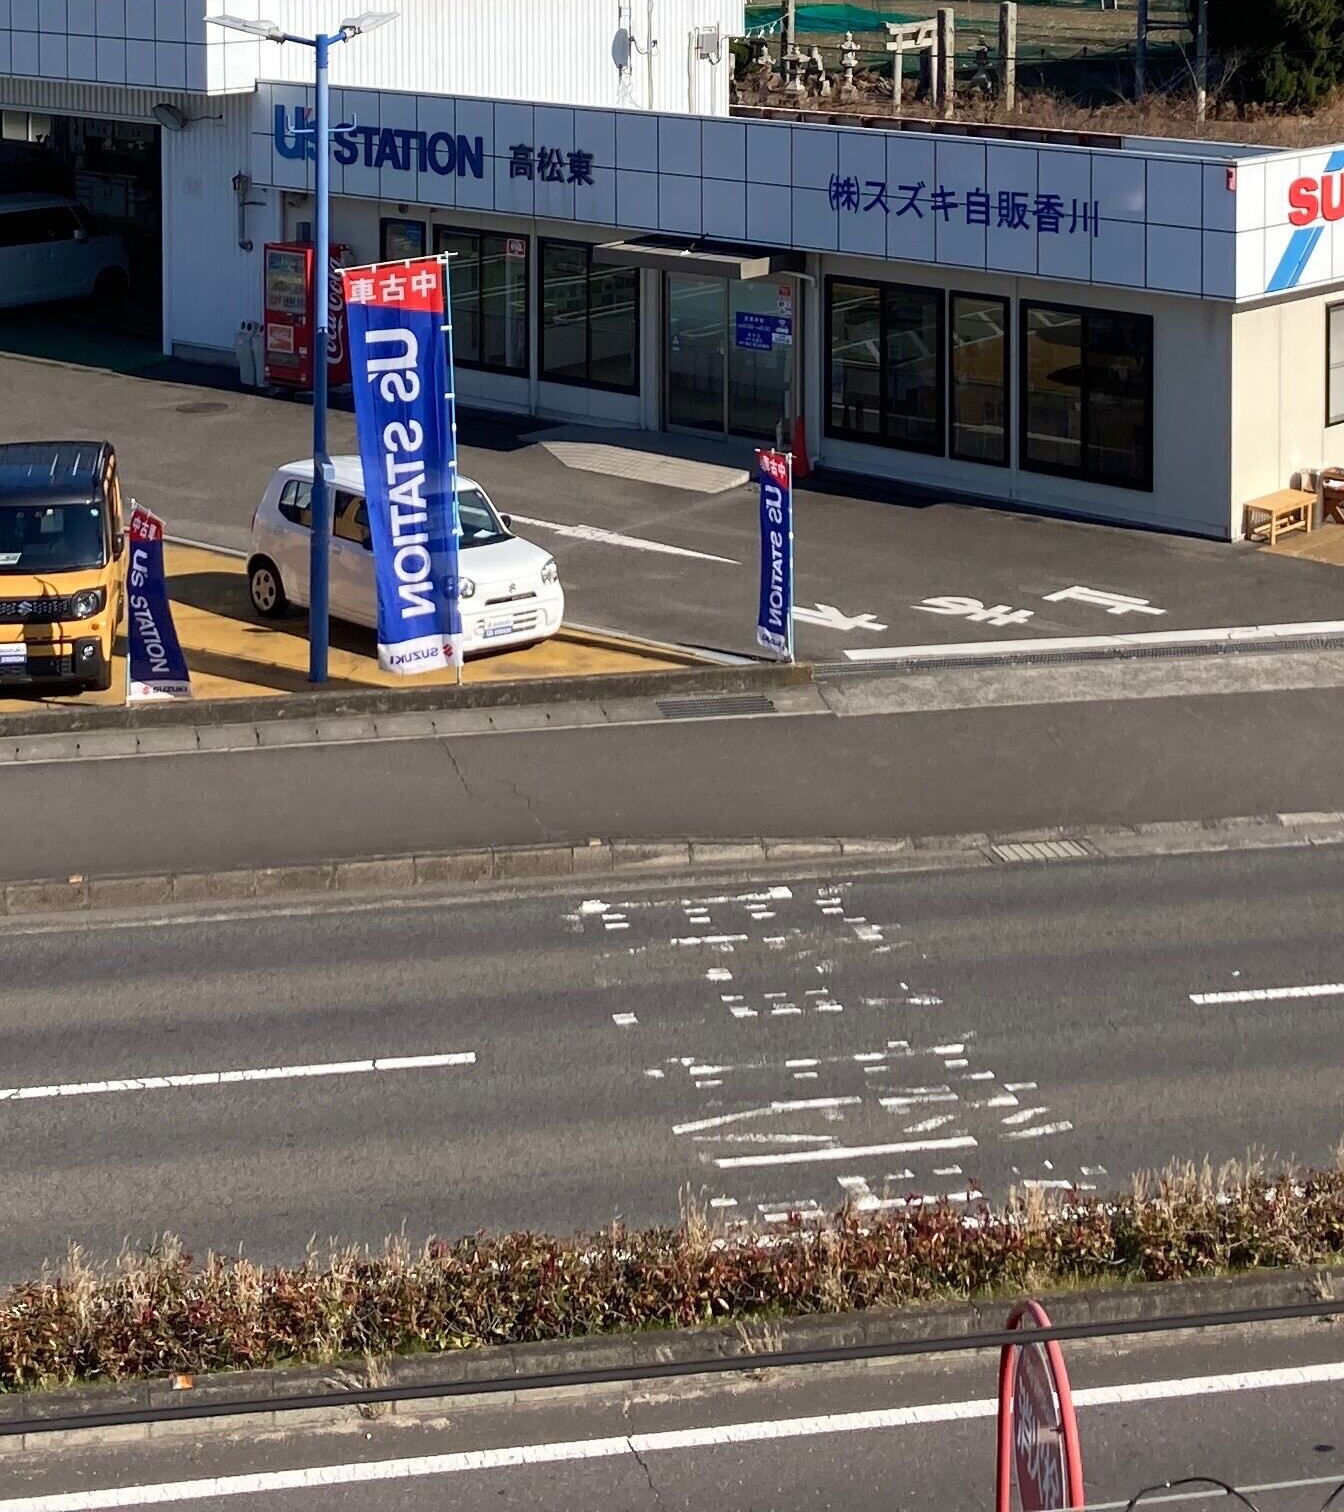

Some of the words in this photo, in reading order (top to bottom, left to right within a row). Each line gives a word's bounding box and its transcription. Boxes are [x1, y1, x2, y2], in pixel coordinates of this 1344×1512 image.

[333, 122, 484, 179] STATION
[509, 143, 595, 186] 高松東
[130, 594, 170, 674] STATION
